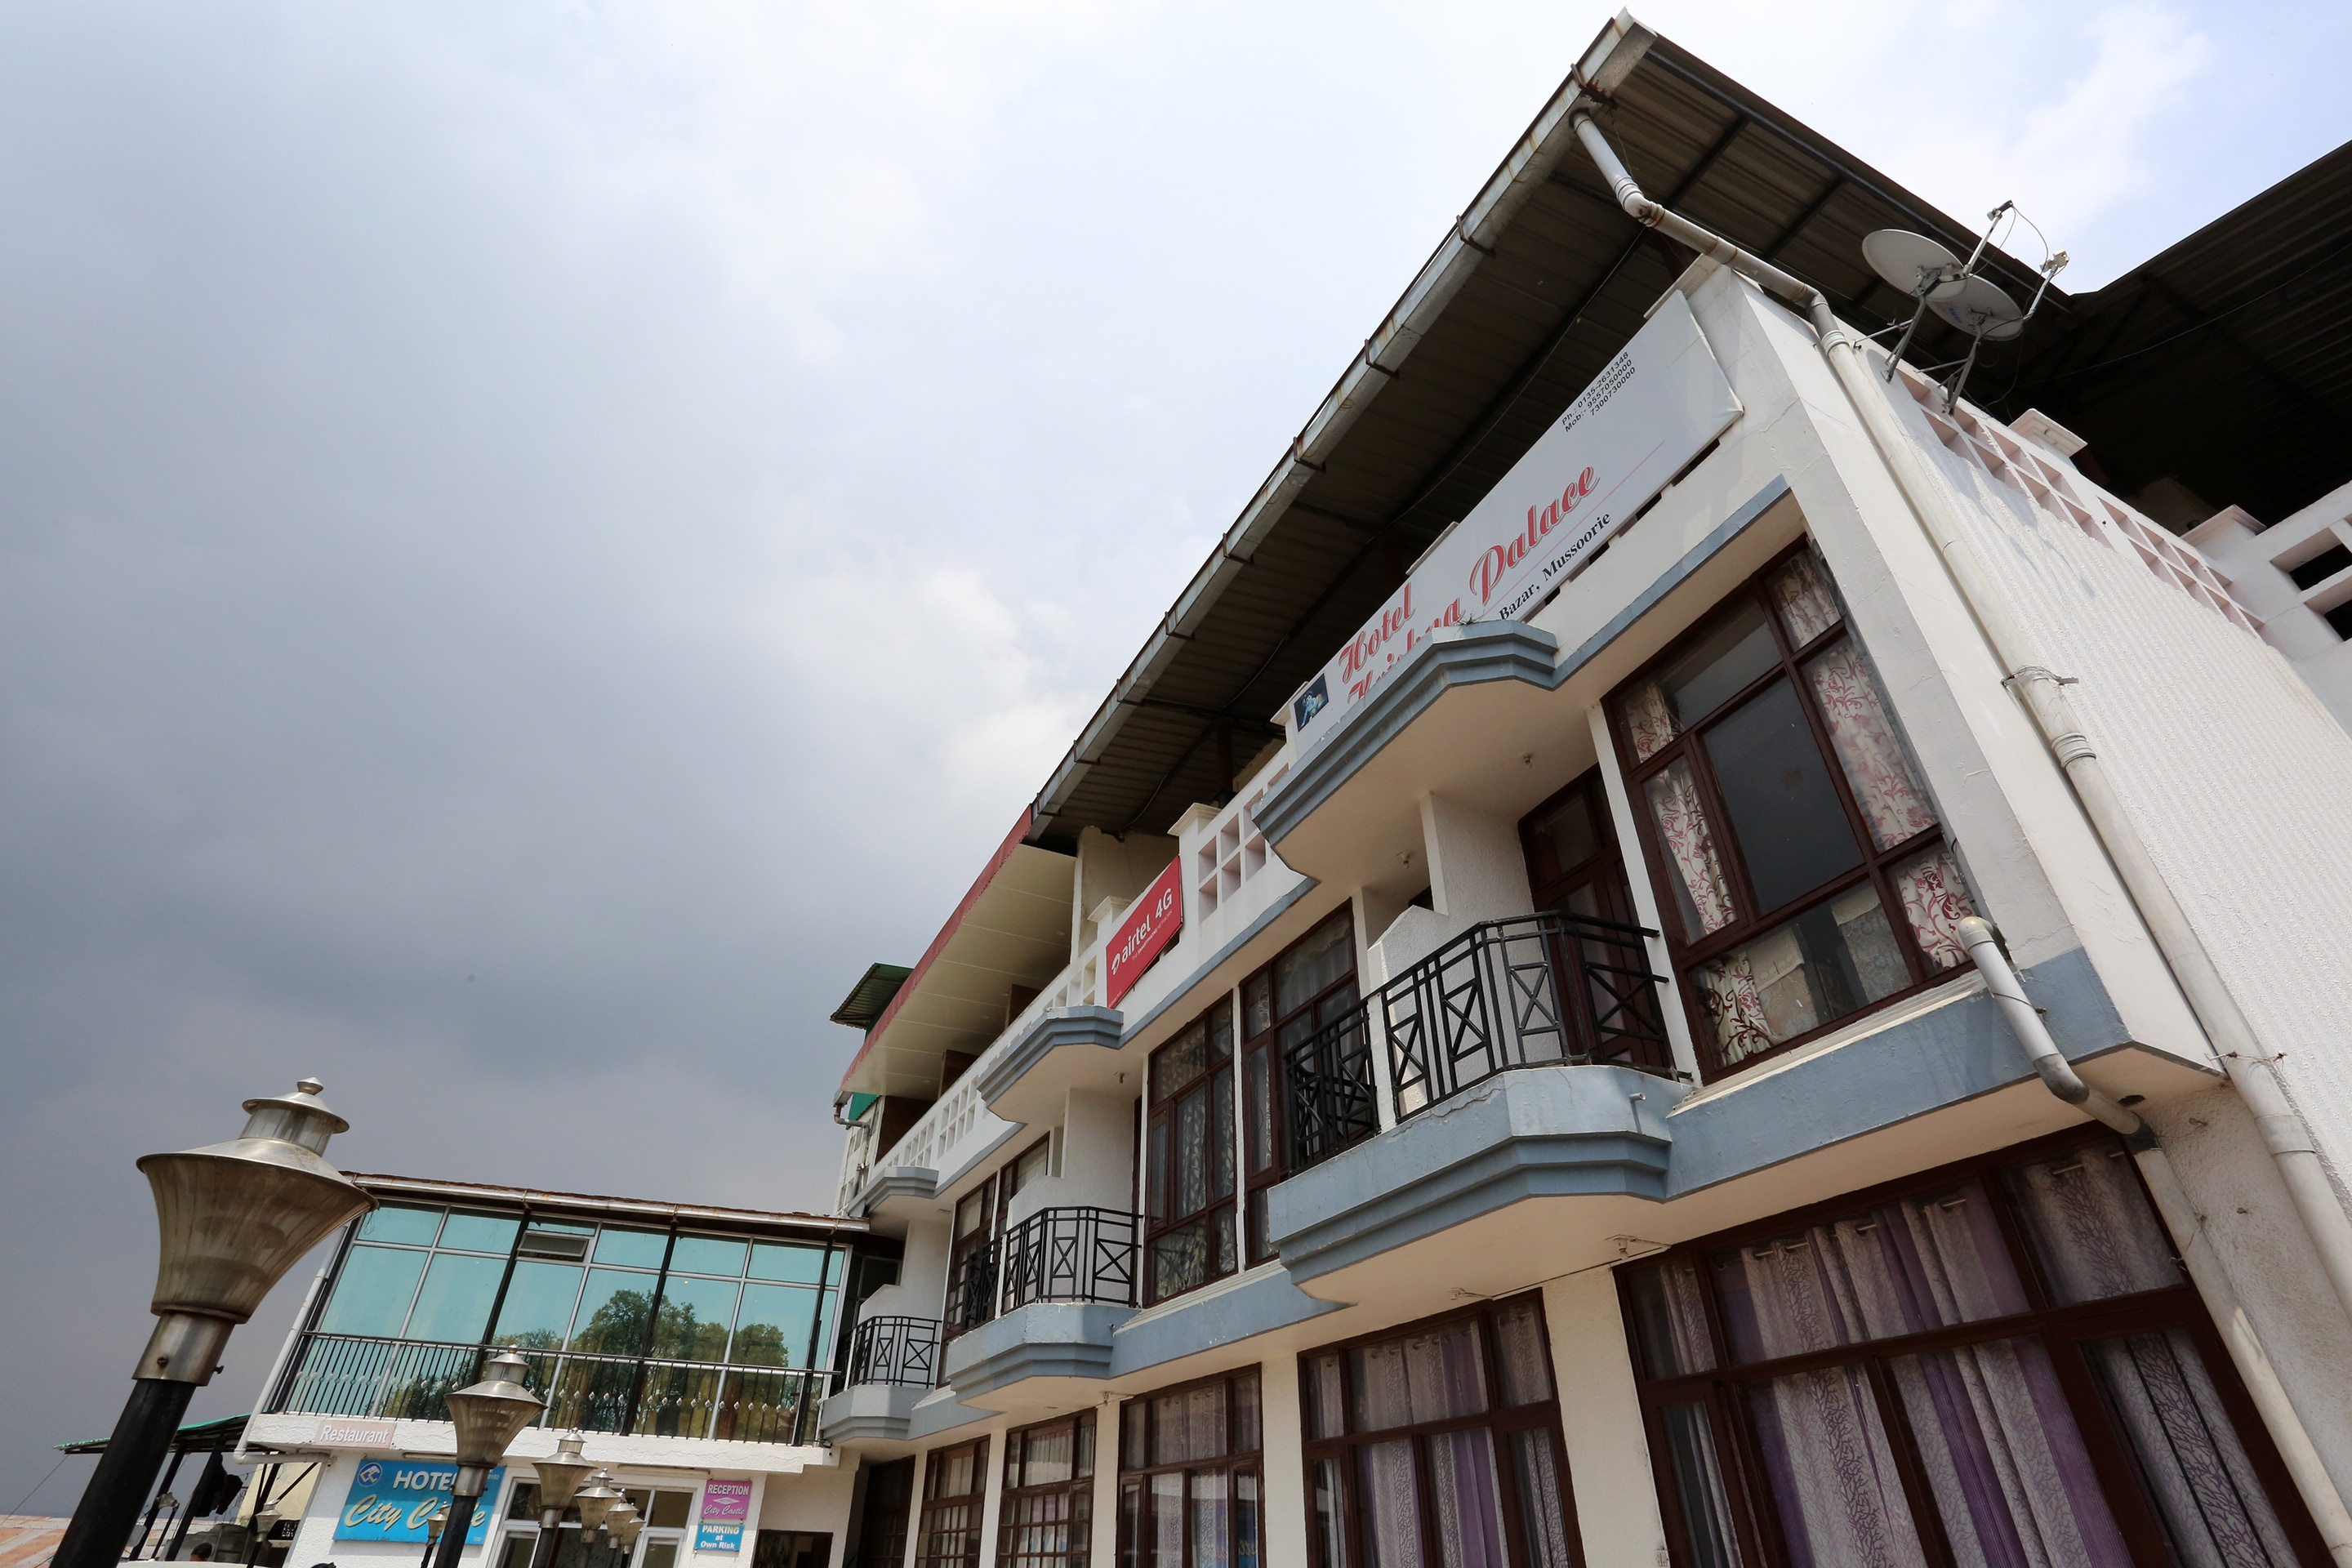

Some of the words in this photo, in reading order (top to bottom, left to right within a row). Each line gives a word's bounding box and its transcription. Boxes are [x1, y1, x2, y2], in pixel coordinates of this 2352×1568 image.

[1577, 352, 1629, 408] 0135-2631348
[1587, 359, 1633, 409] 9557050000
[1589, 366, 1636, 416] 7300730000
[1469, 466, 1601, 607] Palace
[1499, 583, 1541, 621] Bazar,
[1541, 512, 1611, 582] Mussoorie
[1338, 581, 1416, 684] Hotel
[1121, 913, 1152, 964] airtel
[1155, 887, 1173, 919] 4G
[319, 1424, 390, 1445] Restaurant
[344, 1494, 403, 1532] City
[703, 1503, 720, 1516] City
[721, 1504, 745, 1516] Castle
[707, 1484, 750, 1496] RECEPTION
[700, 1540, 717, 1548] Own
[719, 1541, 736, 1549] Risk
[702, 1525, 740, 1535] PARKING
